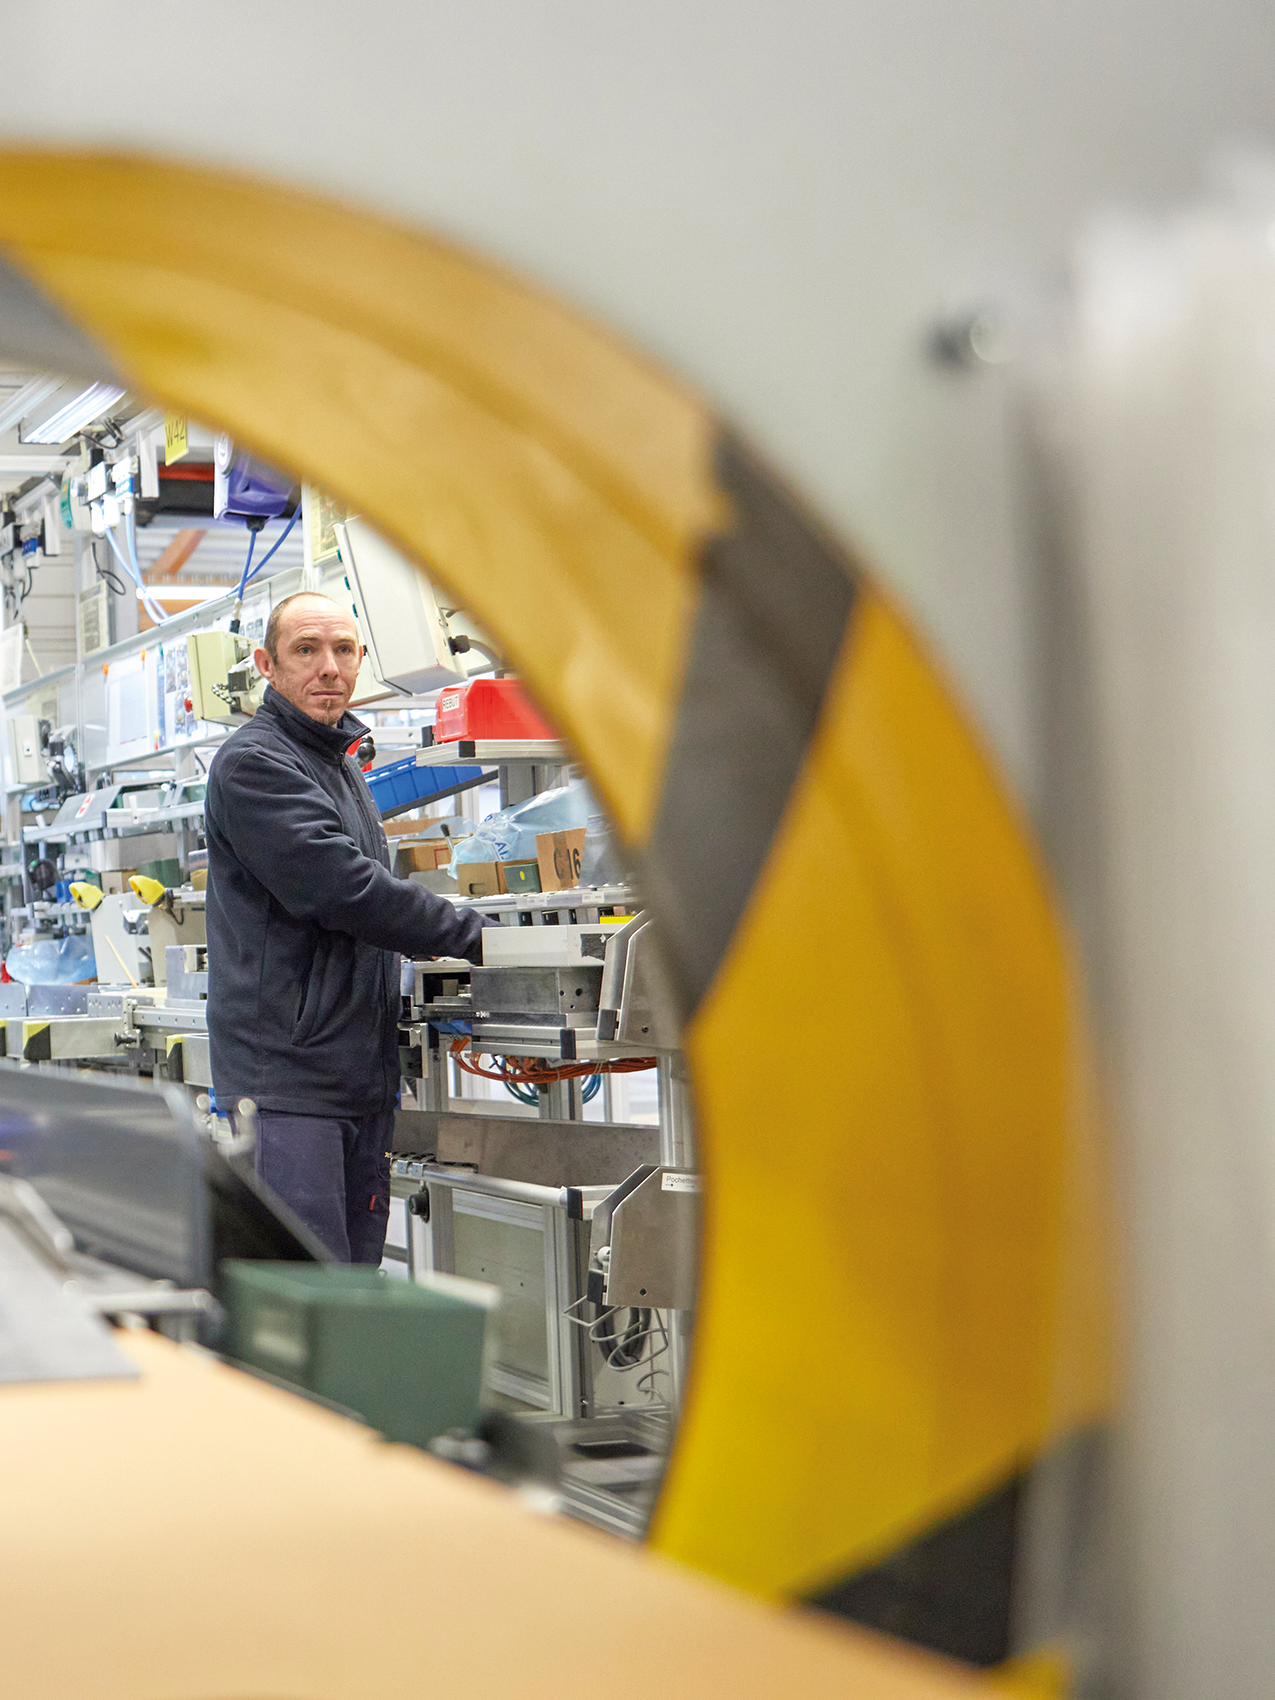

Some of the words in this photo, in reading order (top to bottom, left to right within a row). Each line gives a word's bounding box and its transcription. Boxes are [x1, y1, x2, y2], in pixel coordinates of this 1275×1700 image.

[165, 417, 185, 448] W42
[442, 695, 458, 709] REBUT
[566, 848, 581, 880] 16
[666, 1175, 697, 1185] Pochette
